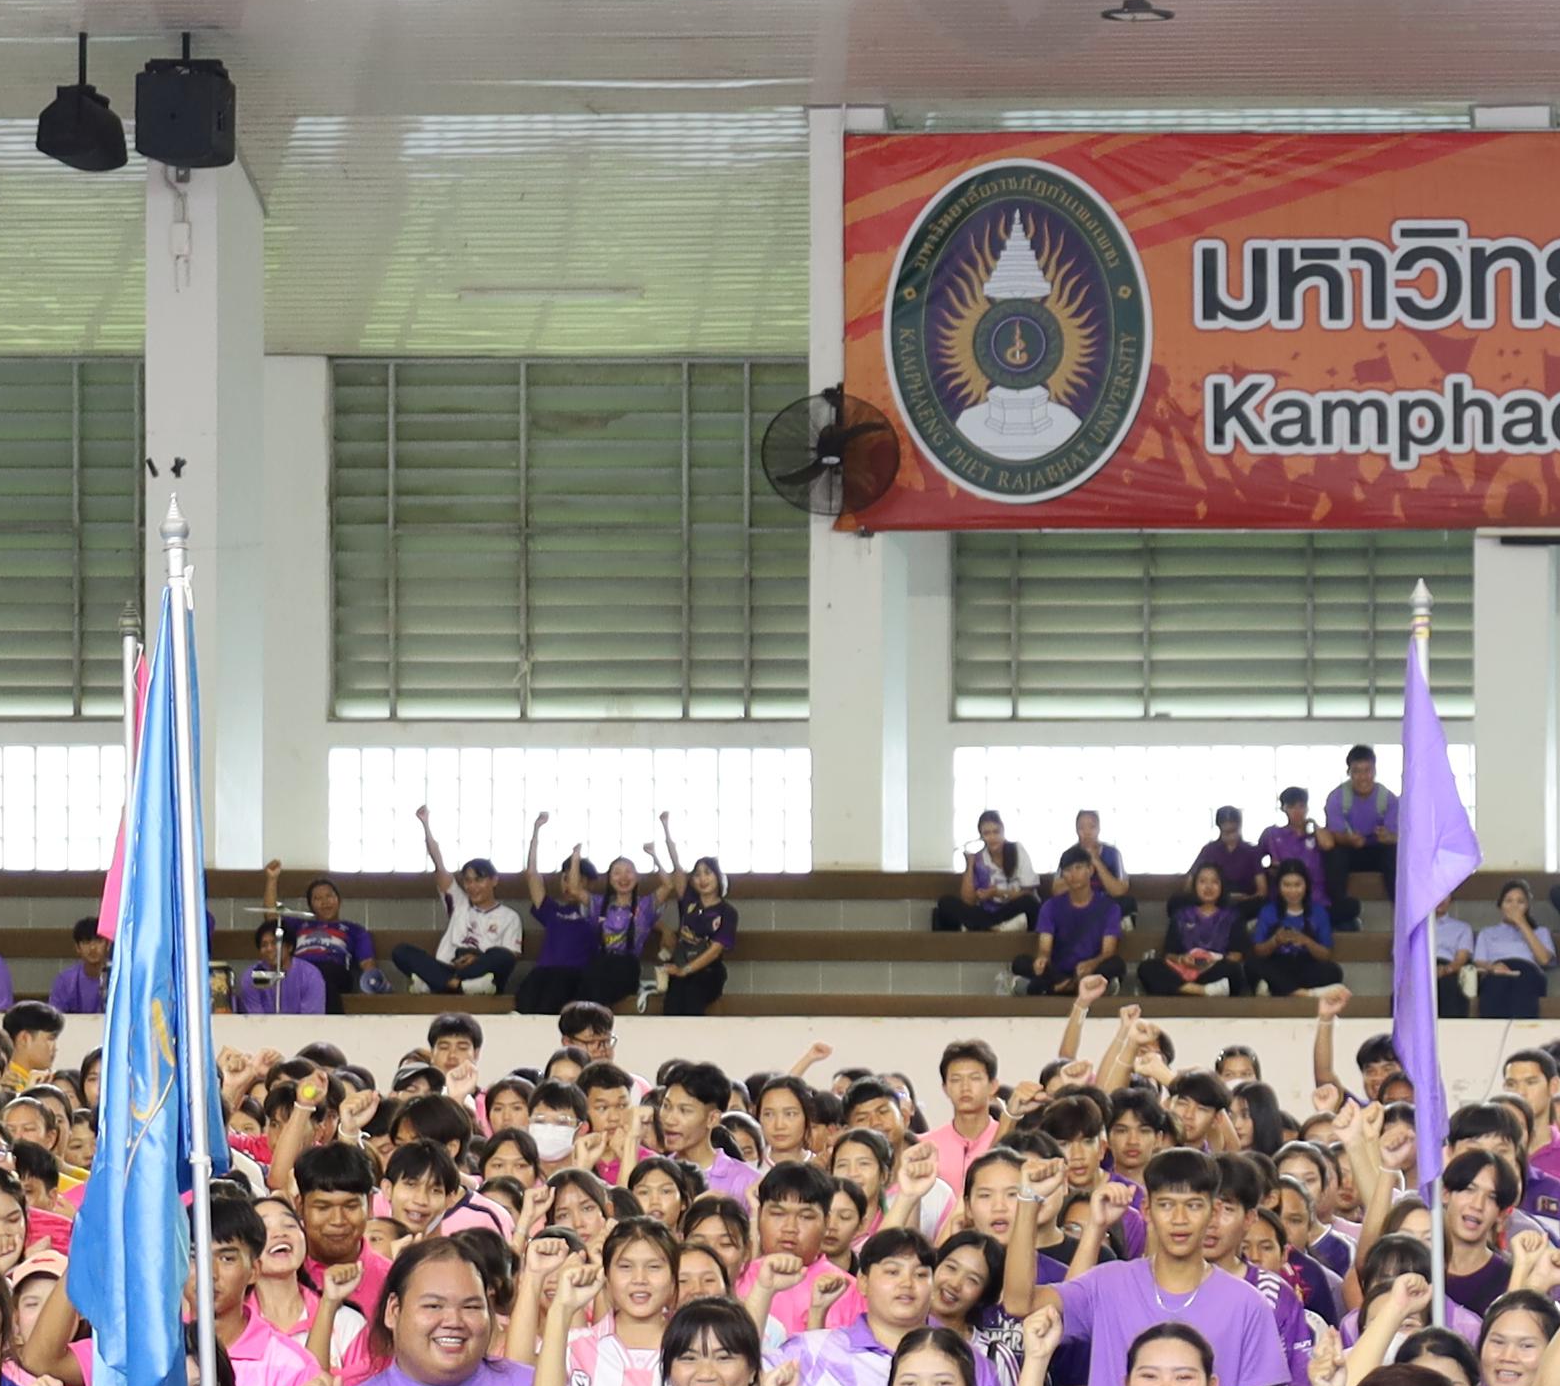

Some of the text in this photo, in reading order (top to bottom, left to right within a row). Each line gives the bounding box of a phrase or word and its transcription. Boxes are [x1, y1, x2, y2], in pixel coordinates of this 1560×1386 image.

[899, 327, 1137, 492] KAMPHAENG PHET RAJABHAT UNIVERSITY
